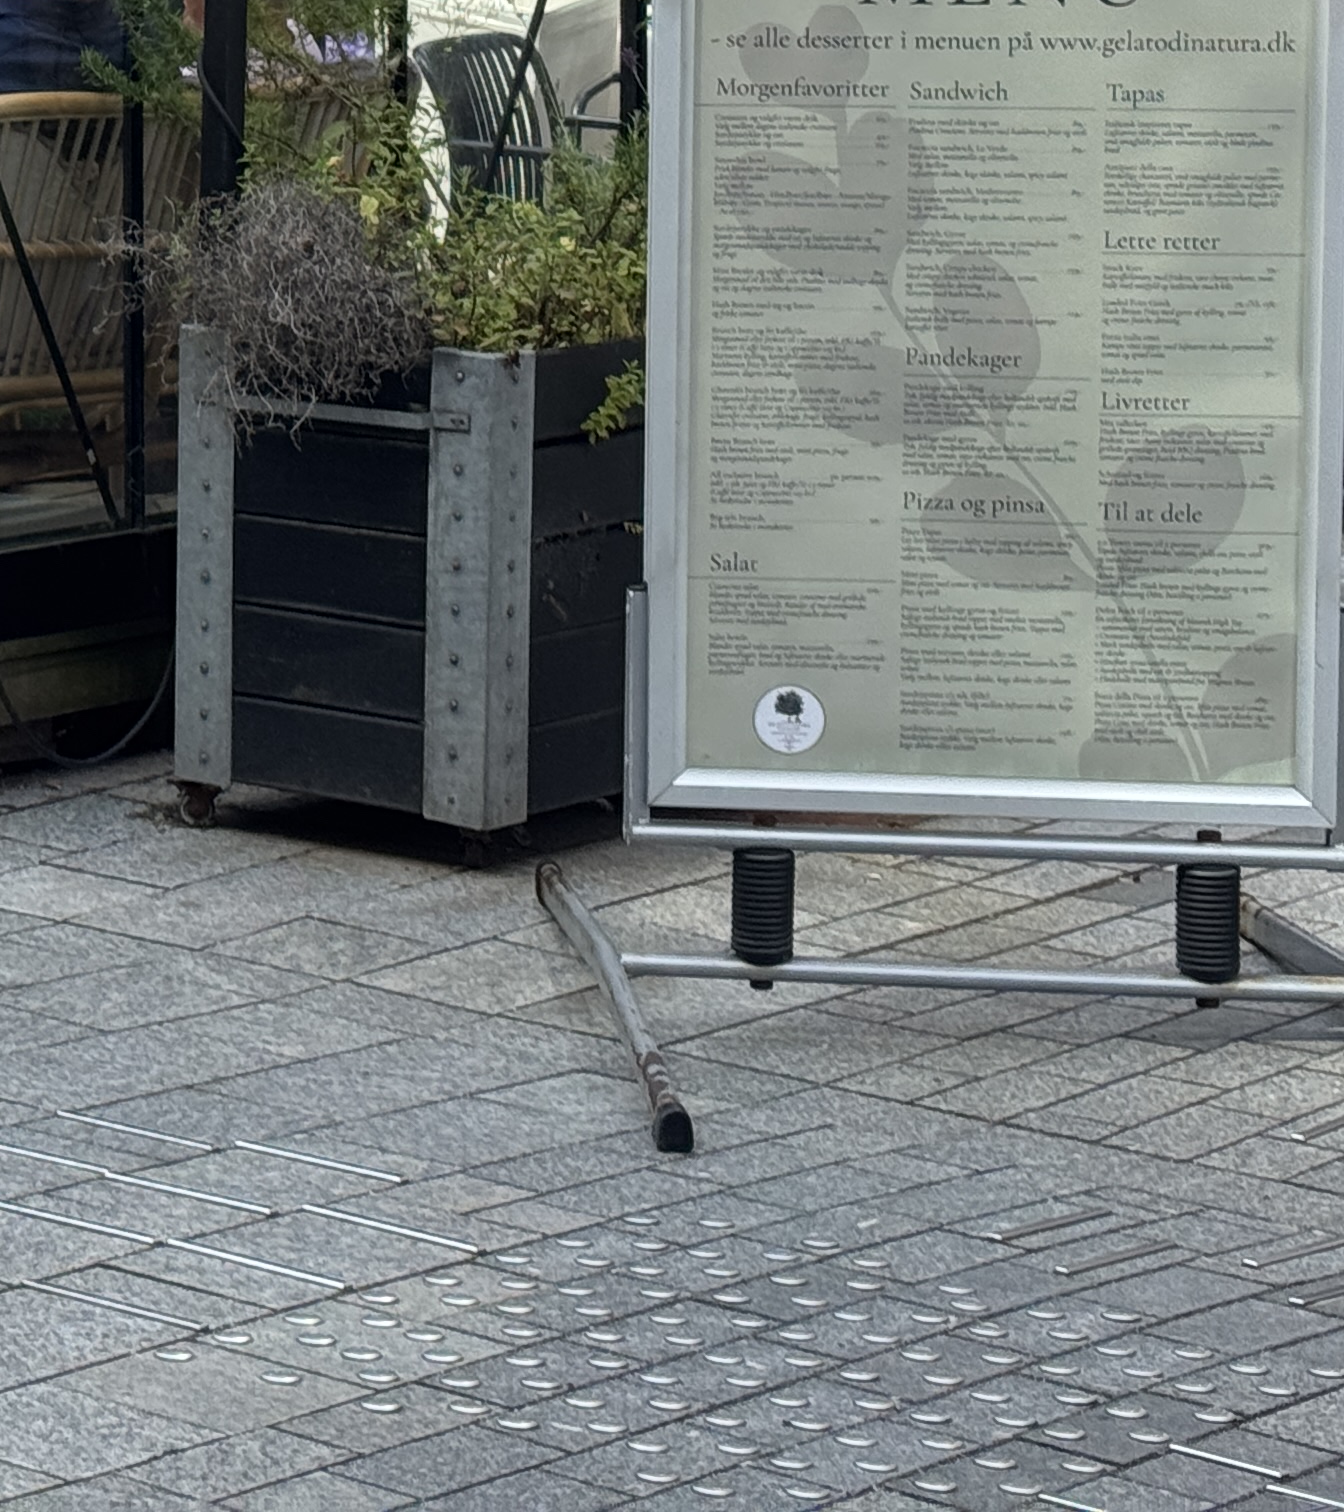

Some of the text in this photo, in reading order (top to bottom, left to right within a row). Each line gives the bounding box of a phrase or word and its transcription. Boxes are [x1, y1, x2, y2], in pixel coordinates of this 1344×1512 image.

[726, 34, 747, 49] se
[753, 26, 790, 49] alle
[797, 26, 890, 50] desserter
[901, 30, 907, 50] i
[914, 36, 1001, 50] menuen
[1008, 31, 1034, 58] på
[1039, 29, 1296, 59] www.gelatodinatura.dk
[716, 76, 889, 103] Morgenfavoritter
[910, 80, 1008, 102] Sandwich
[1108, 83, 1165, 106] Tapas
[1104, 230, 1221, 251] Lette retter
[906, 346, 1022, 374] Pandekager
[1102, 391, 1190, 412] Livretter
[903, 491, 1045, 519] Pizza og pinsa
[1099, 501, 1203, 523] Til at dele
[710, 551, 758, 572] Salat
